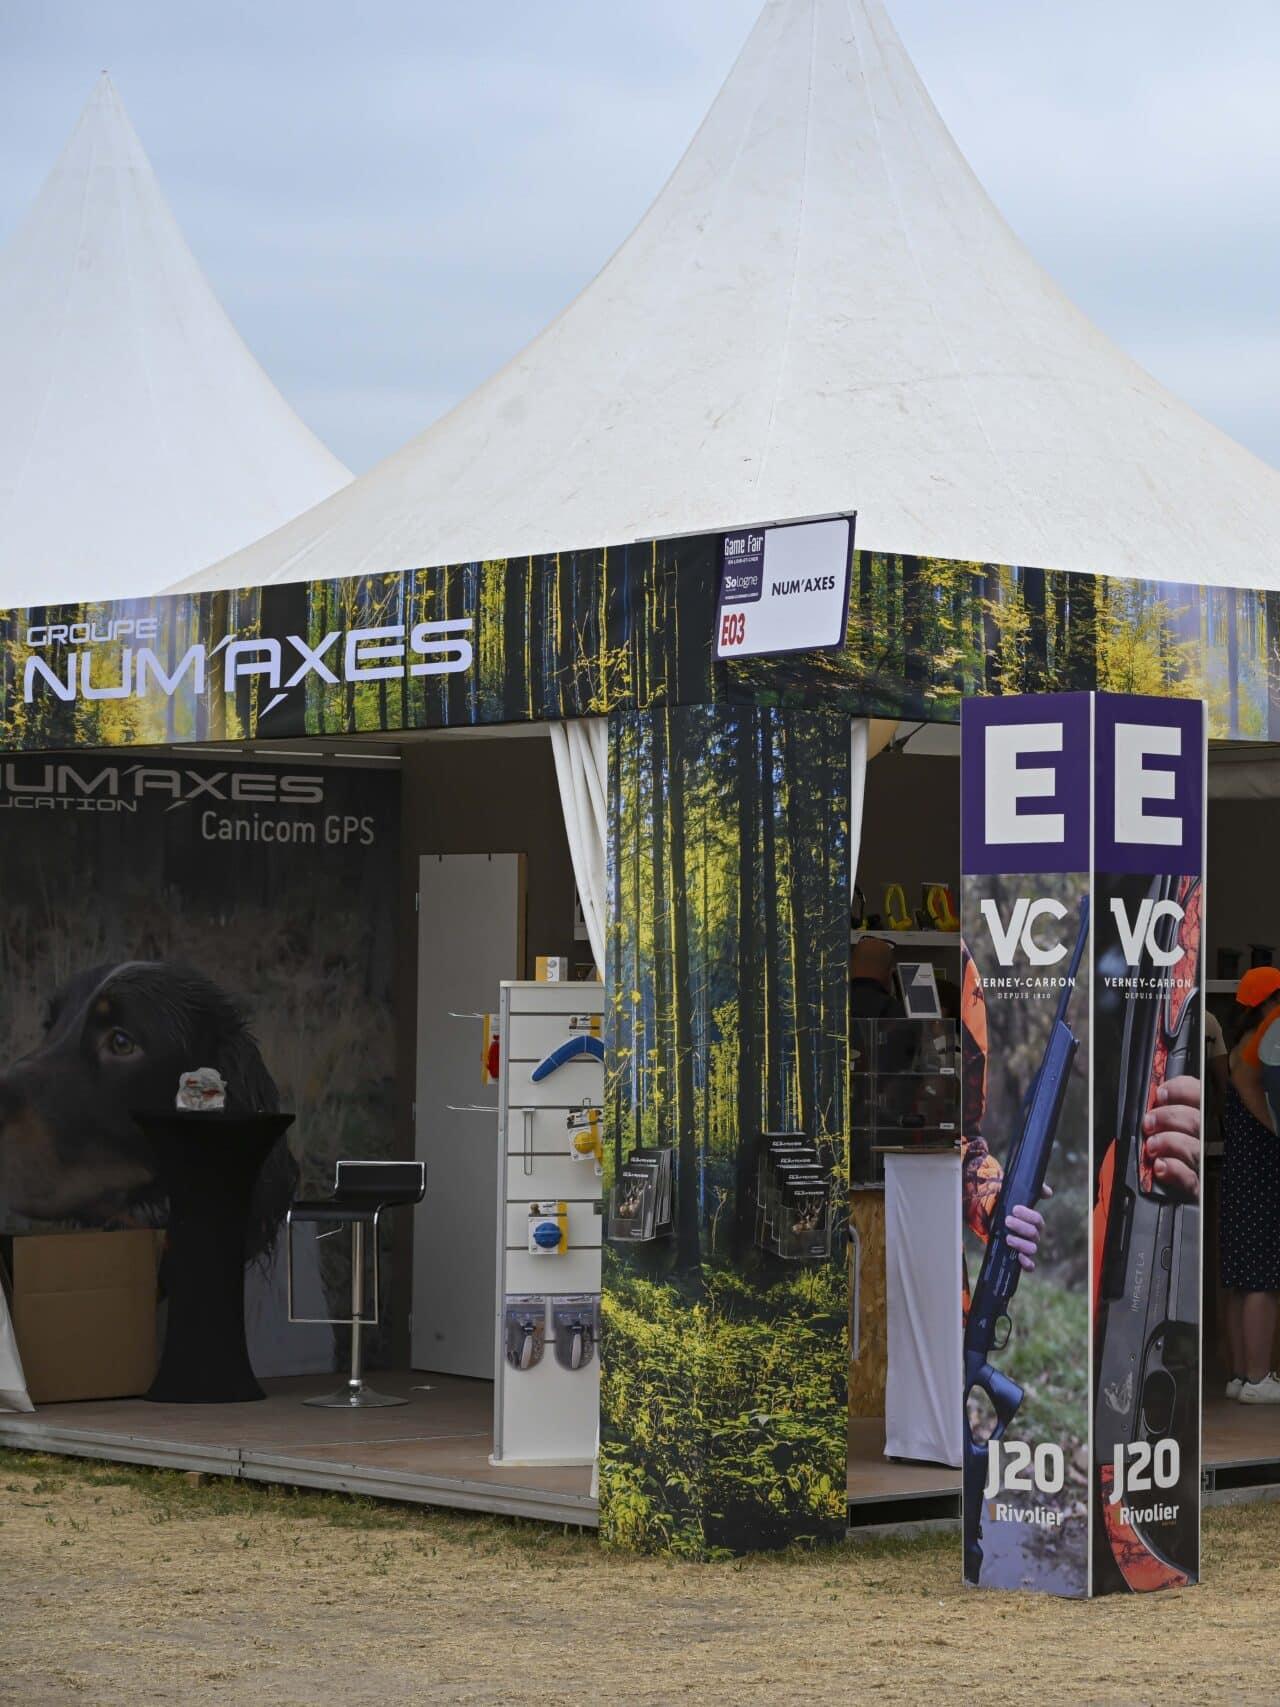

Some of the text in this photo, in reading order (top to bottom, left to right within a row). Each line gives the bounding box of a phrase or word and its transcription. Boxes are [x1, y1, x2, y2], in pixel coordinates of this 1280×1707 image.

[724, 534, 764, 556] Game Fair
[771, 575, 836, 597] NUM'AXES
[26, 617, 159, 648] GROUPE
[720, 612, 746, 647] E03
[23, 617, 474, 704] NUM'AXES
[0, 763, 325, 804] UM'AXES
[984, 721, 1065, 845] E
[1113, 722, 1183, 846] E
[201, 810, 375, 845] Canicom GPS
[980, 897, 1069, 967] VC
[1109, 897, 1186, 967] VC
[974, 976, 1077, 988] VERNEY-CARRON
[997, 992, 1029, 1000] DEPUIS
[1103, 976, 1192, 989] VERNEY-CARRON
[983, 1439, 1065, 1500] J20
[1108, 1438, 1181, 1505] J20
[995, 1503, 1064, 1527] Rivolier
[1119, 1503, 1180, 1526] Rivolier
